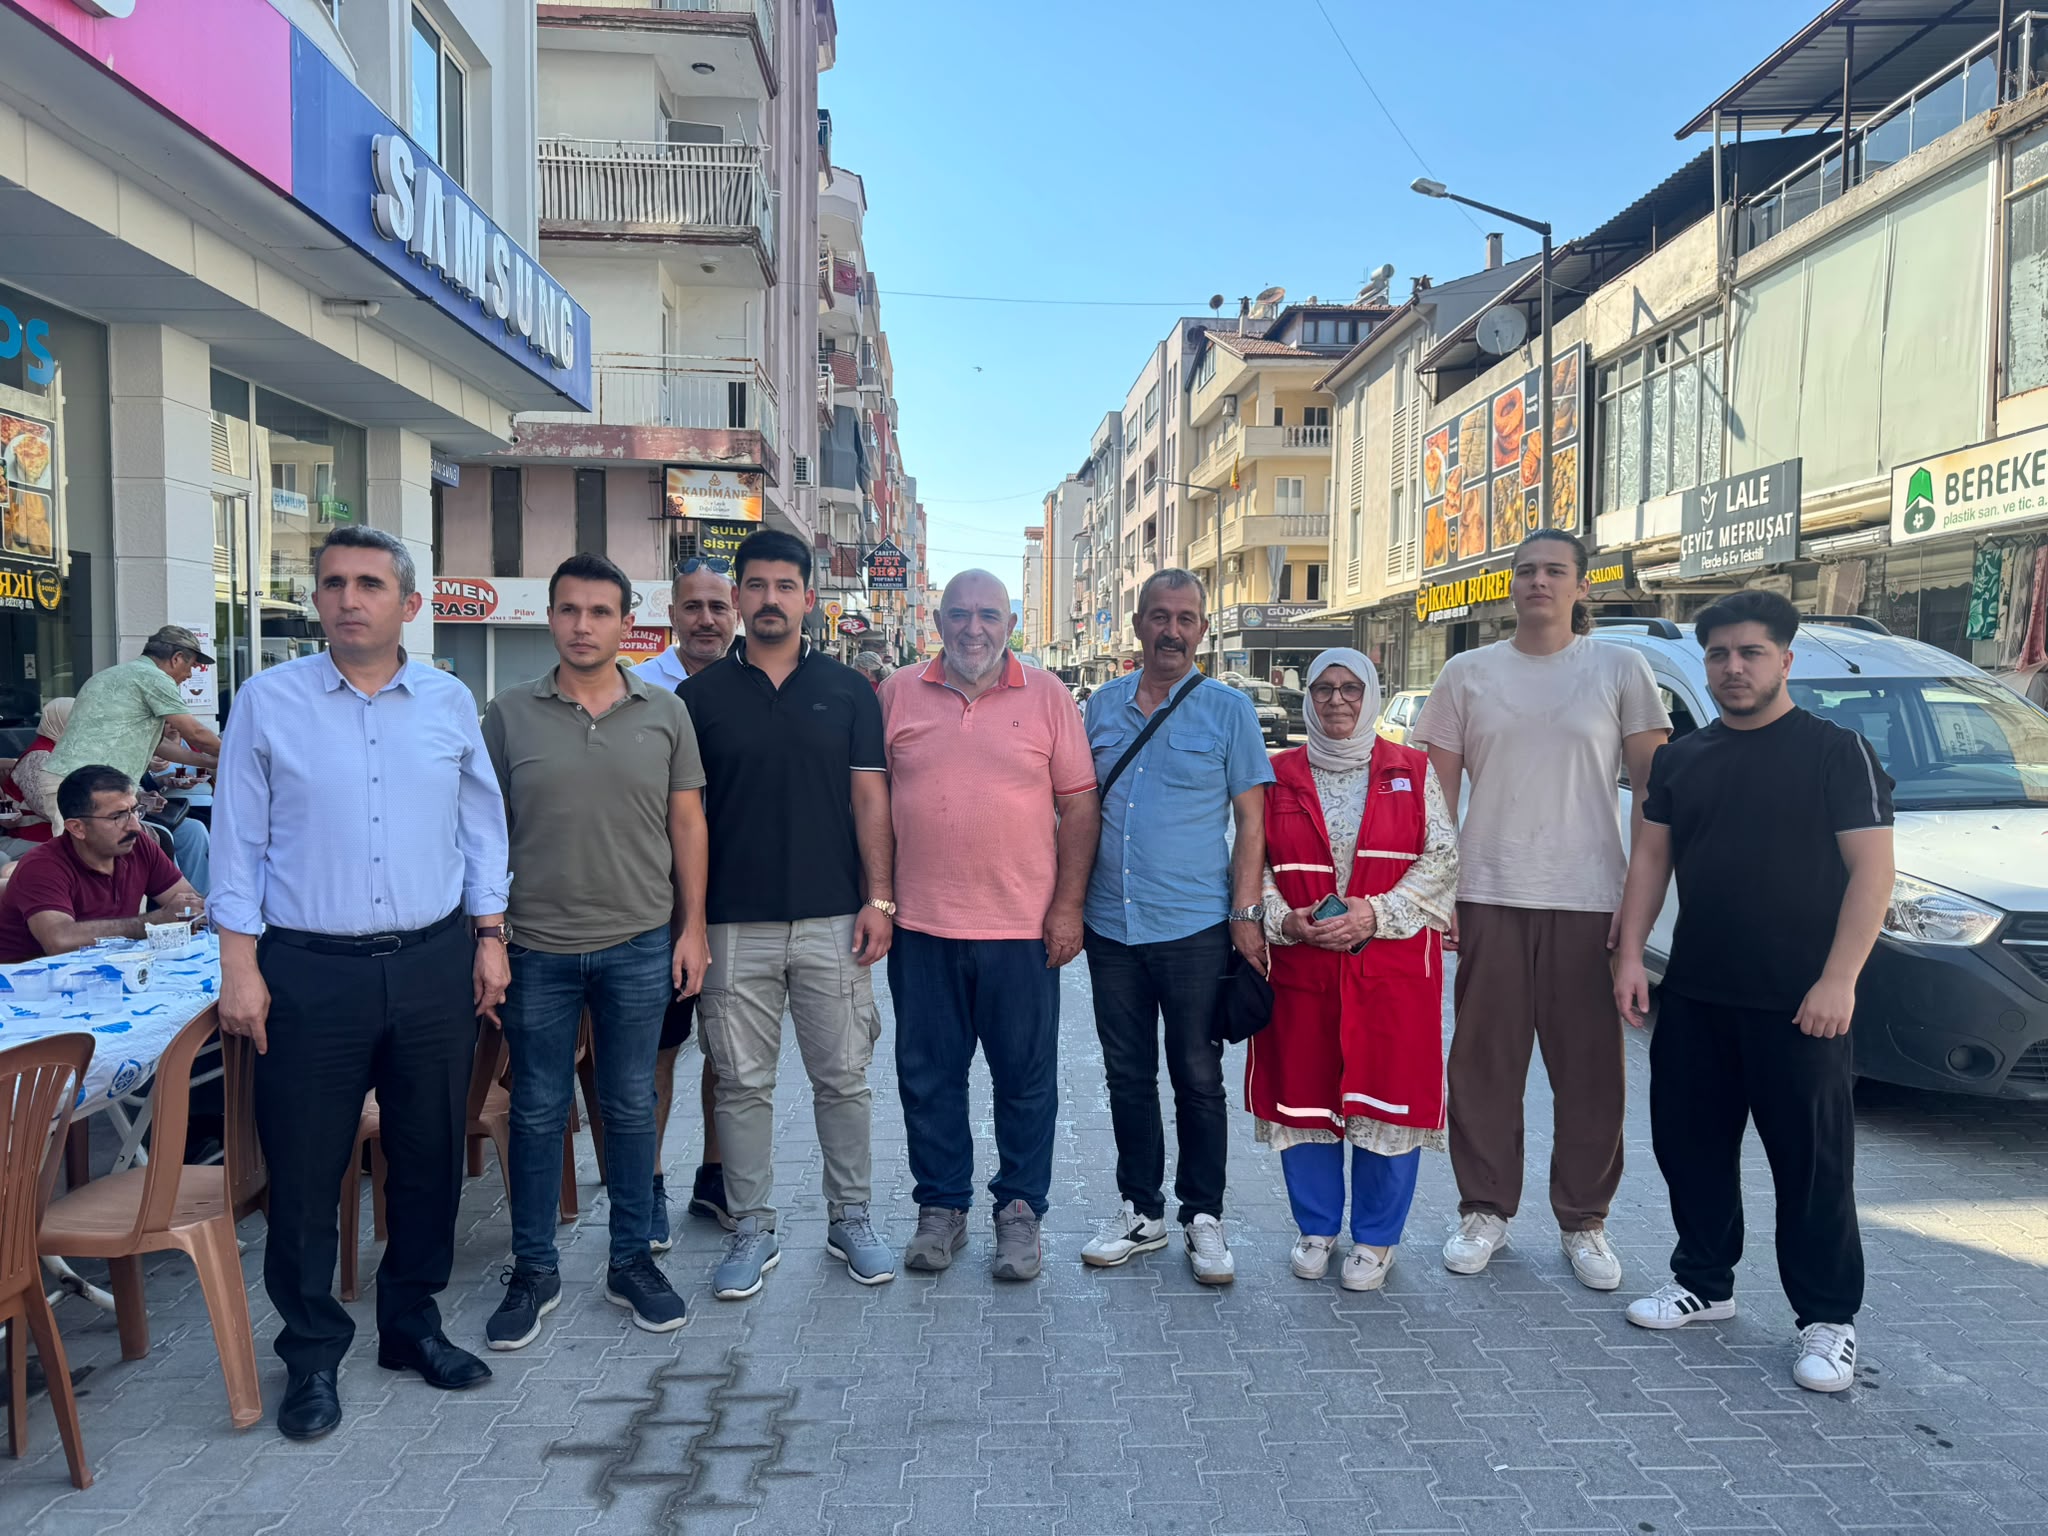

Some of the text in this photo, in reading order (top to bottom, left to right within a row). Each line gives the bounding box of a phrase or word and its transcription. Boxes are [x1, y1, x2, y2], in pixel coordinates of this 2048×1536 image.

[371, 132, 574, 370] SAMSUNG
[1945, 448, 2048, 506] BEREKE
[1726, 473, 1770, 513] LALE
[1943, 508, 1976, 529] plastik
[1978, 504, 2000, 520] san.
[2002, 501, 2016, 514] ve
[2018, 496, 2035, 509] tic.
[710, 525, 748, 537] SULU
[1681, 511, 1794, 561] ÇEYİZ MEFRUŞAT
[873, 556, 901, 567] PET
[1701, 553, 1722, 569] Perde
[1722, 551, 1729, 566] &
[1729, 550, 1739, 565] Ev
[869, 566, 907, 578] SHOP
[1590, 563, 1624, 585] SALONU
[1428, 582, 1467, 612] İKRAM
[514, 608, 535, 616] Pilav
[619, 641, 657, 650] SOFRASI
